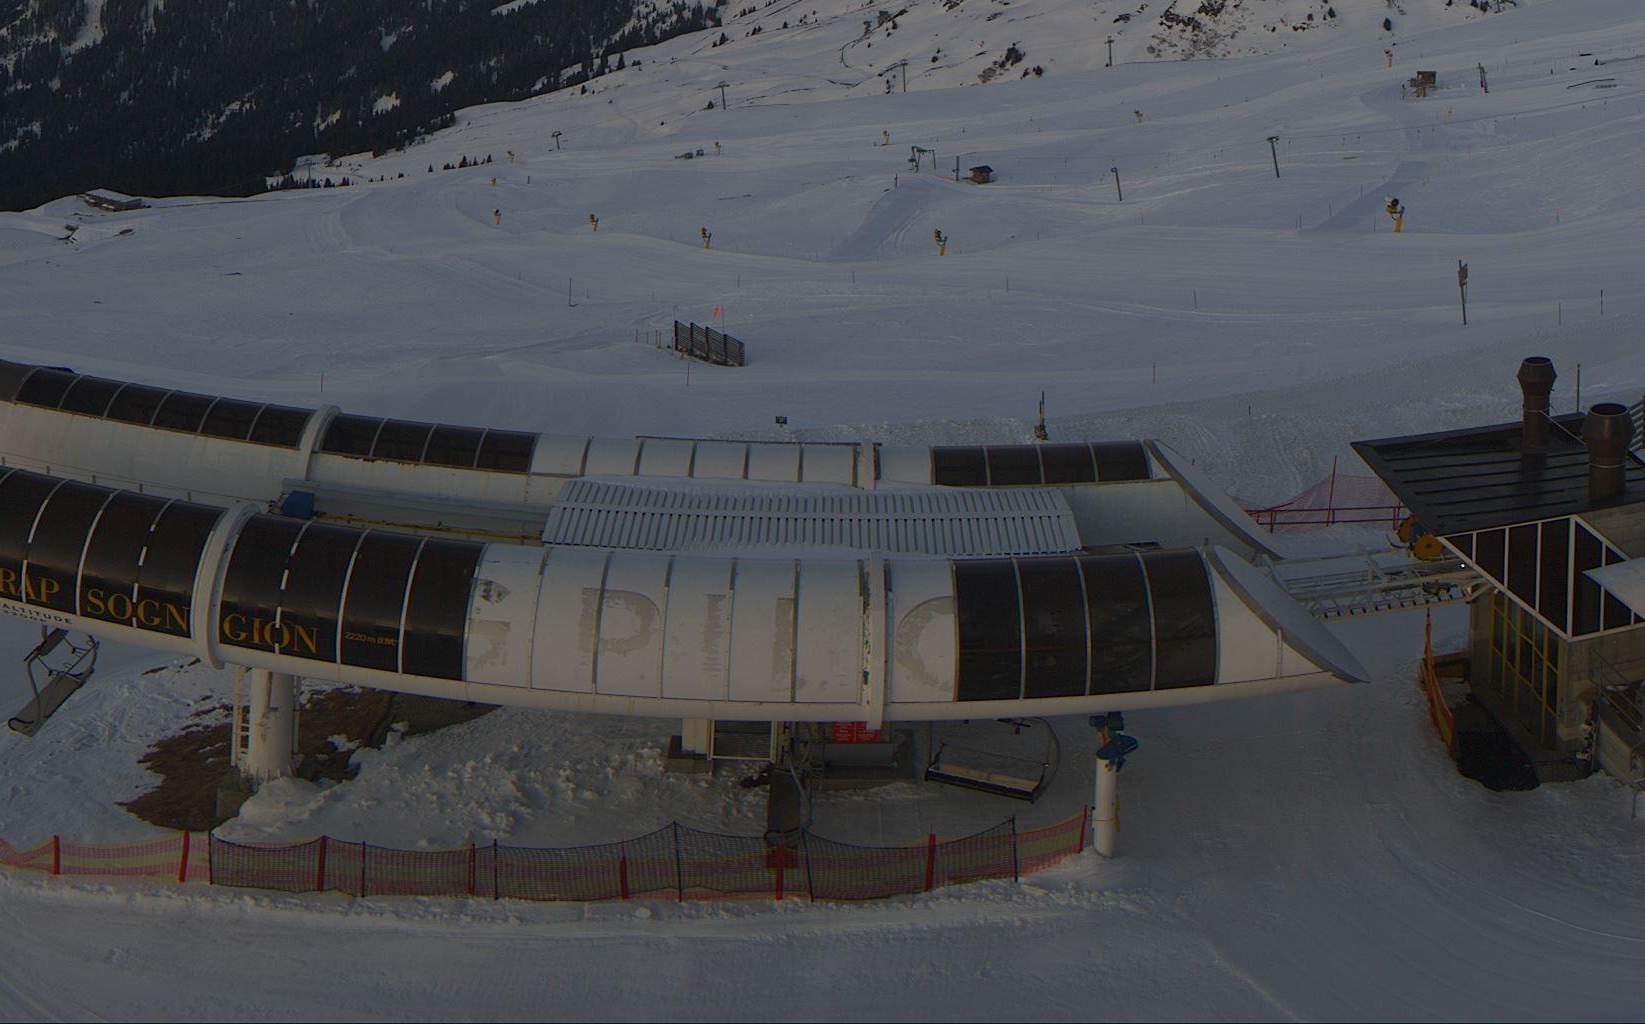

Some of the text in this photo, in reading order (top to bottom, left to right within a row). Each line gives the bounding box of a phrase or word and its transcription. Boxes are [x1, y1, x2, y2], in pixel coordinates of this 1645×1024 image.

[2, 603, 72, 624] ALTITUDE
[86, 588, 189, 632] SOGN
[223, 613, 319, 654] GION
